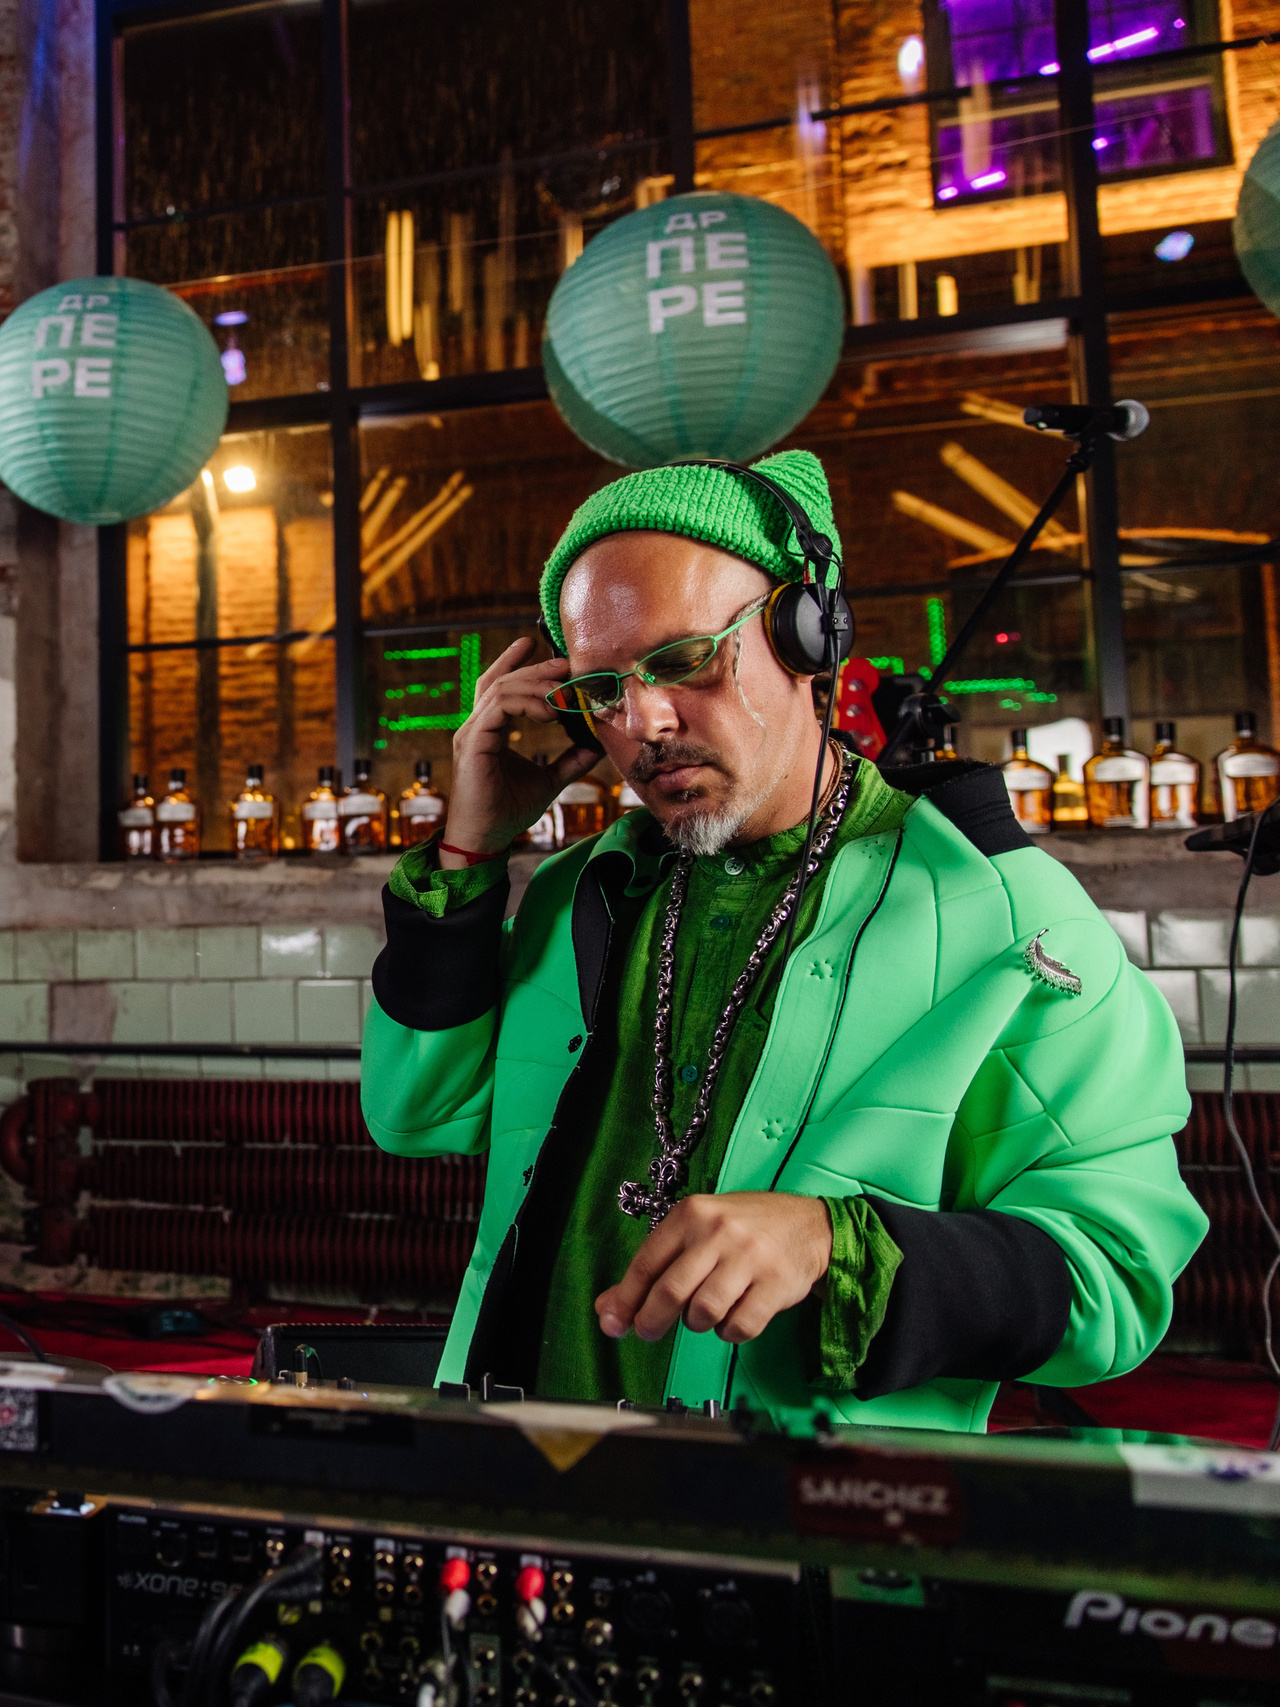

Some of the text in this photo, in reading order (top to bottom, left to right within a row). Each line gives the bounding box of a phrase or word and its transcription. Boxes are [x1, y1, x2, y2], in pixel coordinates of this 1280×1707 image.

[663, 210, 727, 234] ДР
[646, 232, 750, 279] ПЕ
[648, 281, 747, 333] РЕ
[34, 313, 119, 351] ПЕ
[32, 358, 113, 398] РЕ
[1064, 1589, 1280, 1648] Pione
